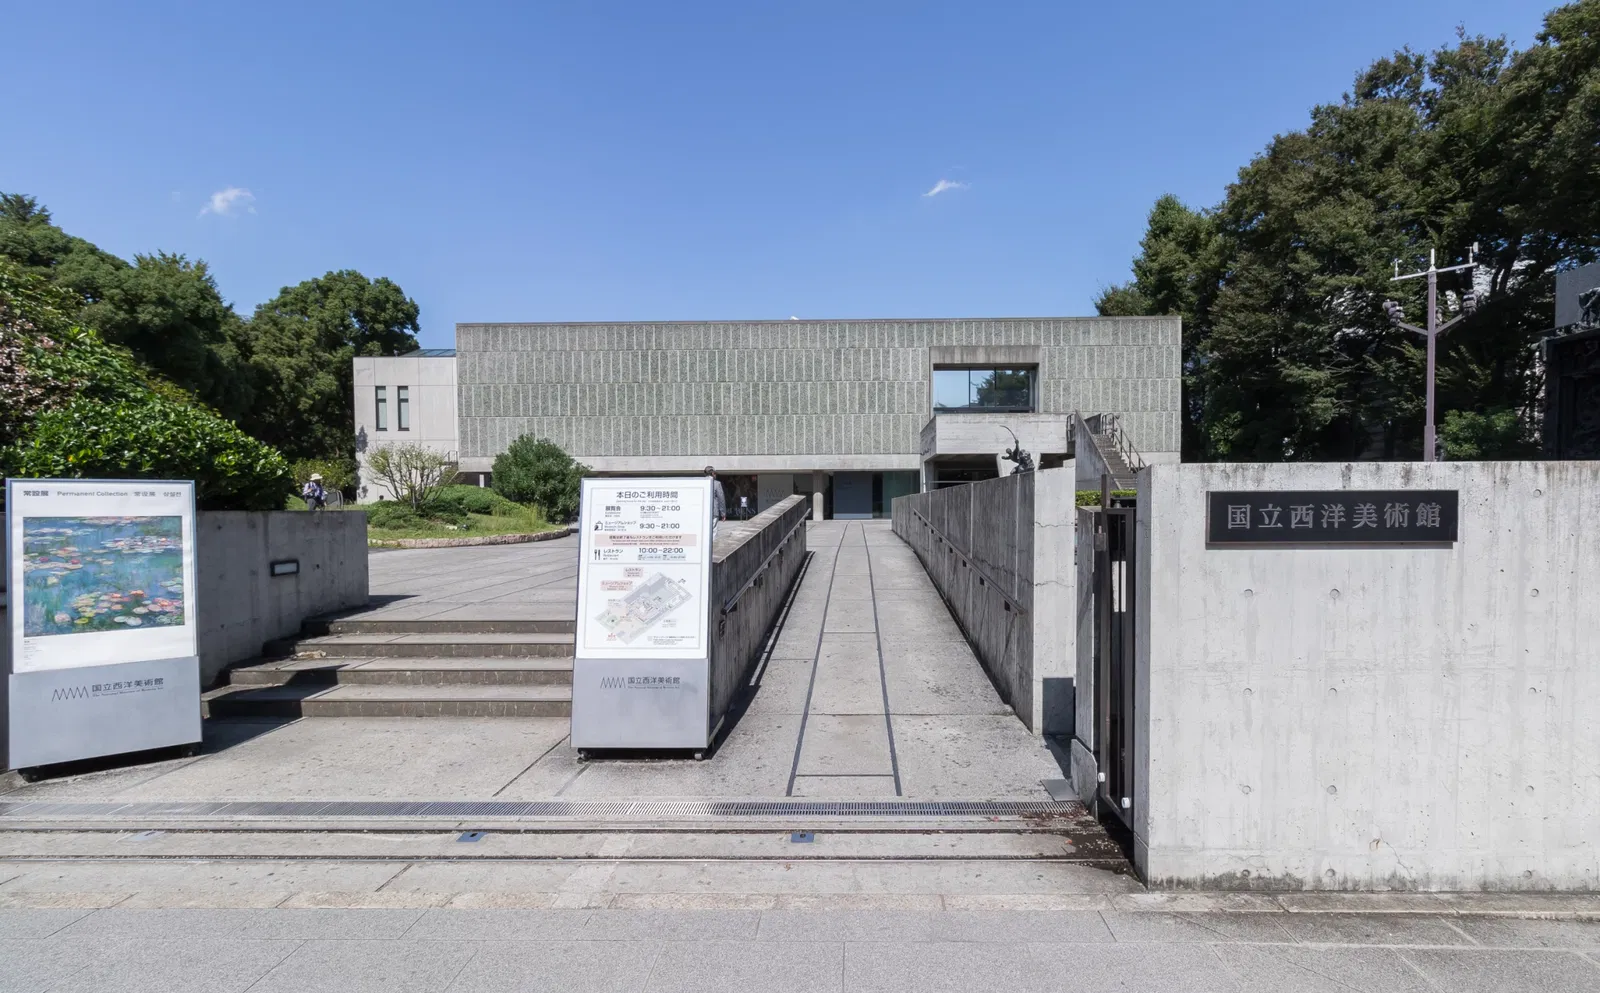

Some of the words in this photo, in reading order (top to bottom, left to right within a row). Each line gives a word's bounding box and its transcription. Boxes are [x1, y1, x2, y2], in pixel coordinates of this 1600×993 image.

[616, 491, 678, 499] 本日のご利用時間
[1227, 502, 1441, 530] 国立西洋美術館
[91, 677, 164, 693] 国立西洋美術館
[627, 676, 681, 685] 国立西洋美術館
